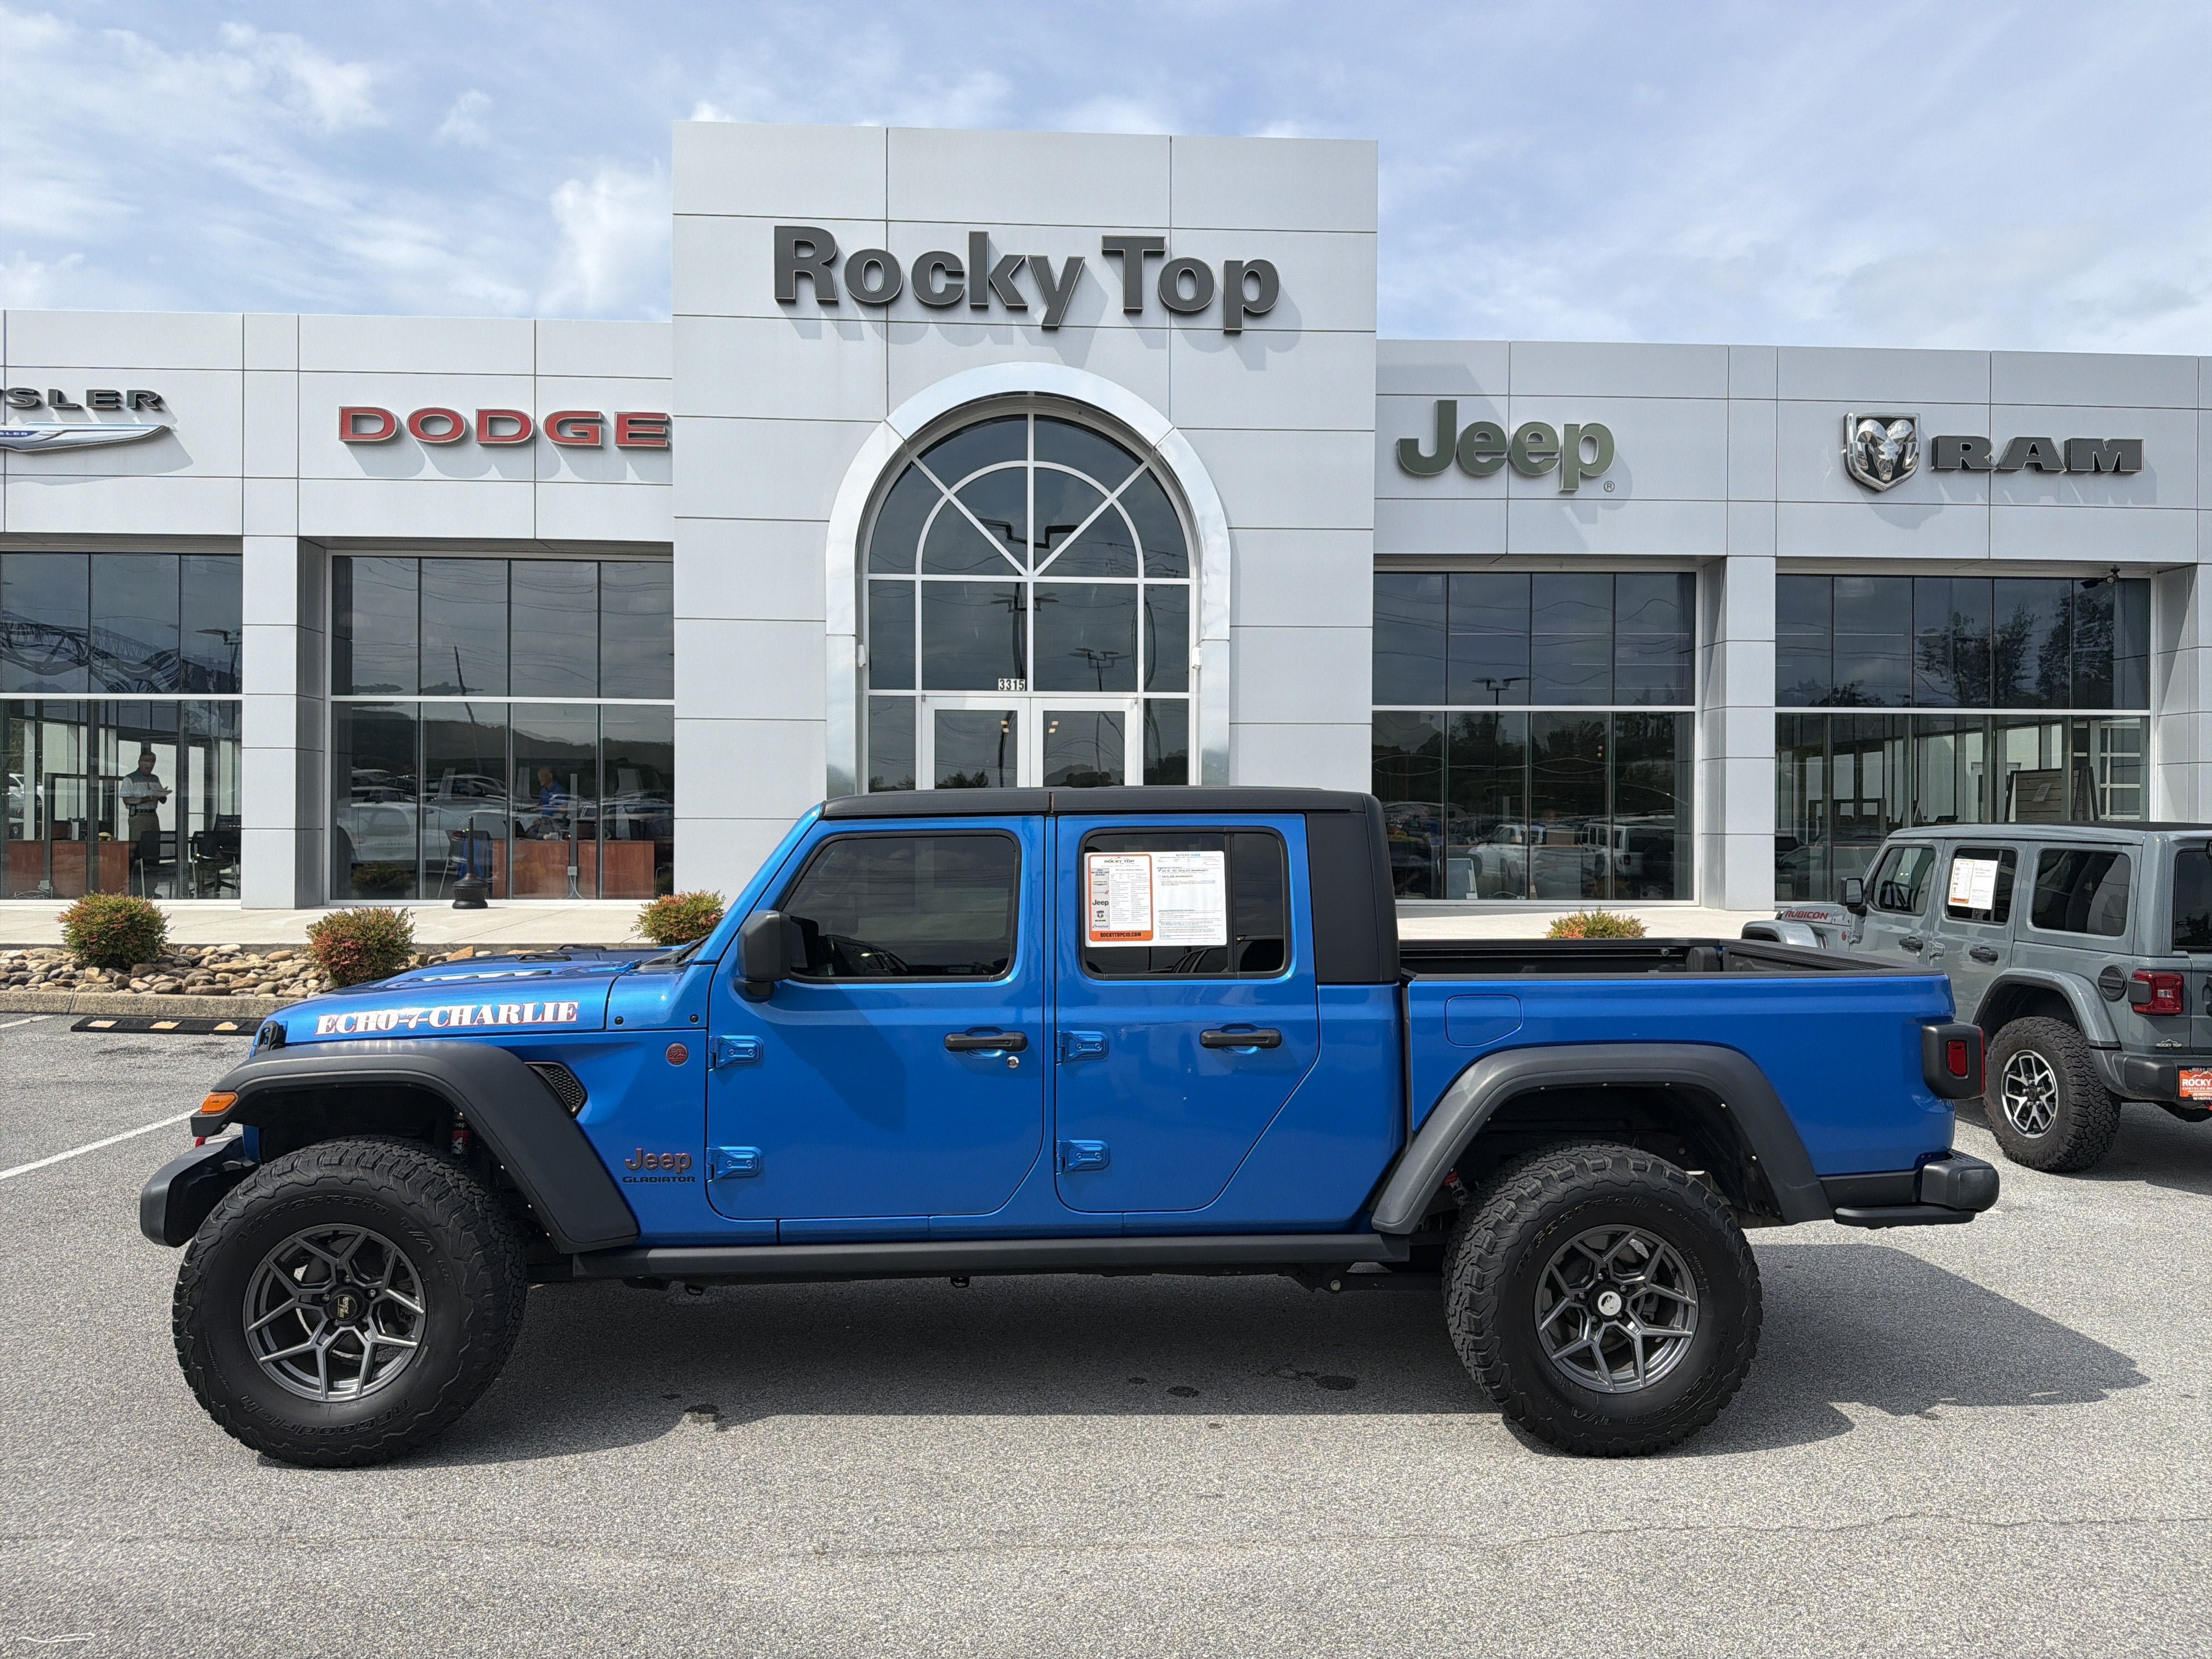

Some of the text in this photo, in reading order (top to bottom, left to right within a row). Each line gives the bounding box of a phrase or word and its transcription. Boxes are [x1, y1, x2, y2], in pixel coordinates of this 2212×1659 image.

[774, 225, 1280, 334] Rocky Top
[0, 387, 162, 409] SLER
[338, 406, 670, 449] DODGE
[1396, 399, 1615, 493] Jeep
[1931, 435, 2145, 473] RAM
[999, 679, 1025, 690] 3315
[1785, 911, 1829, 919] RUBICON
[625, 1148, 692, 1174] Jeep
